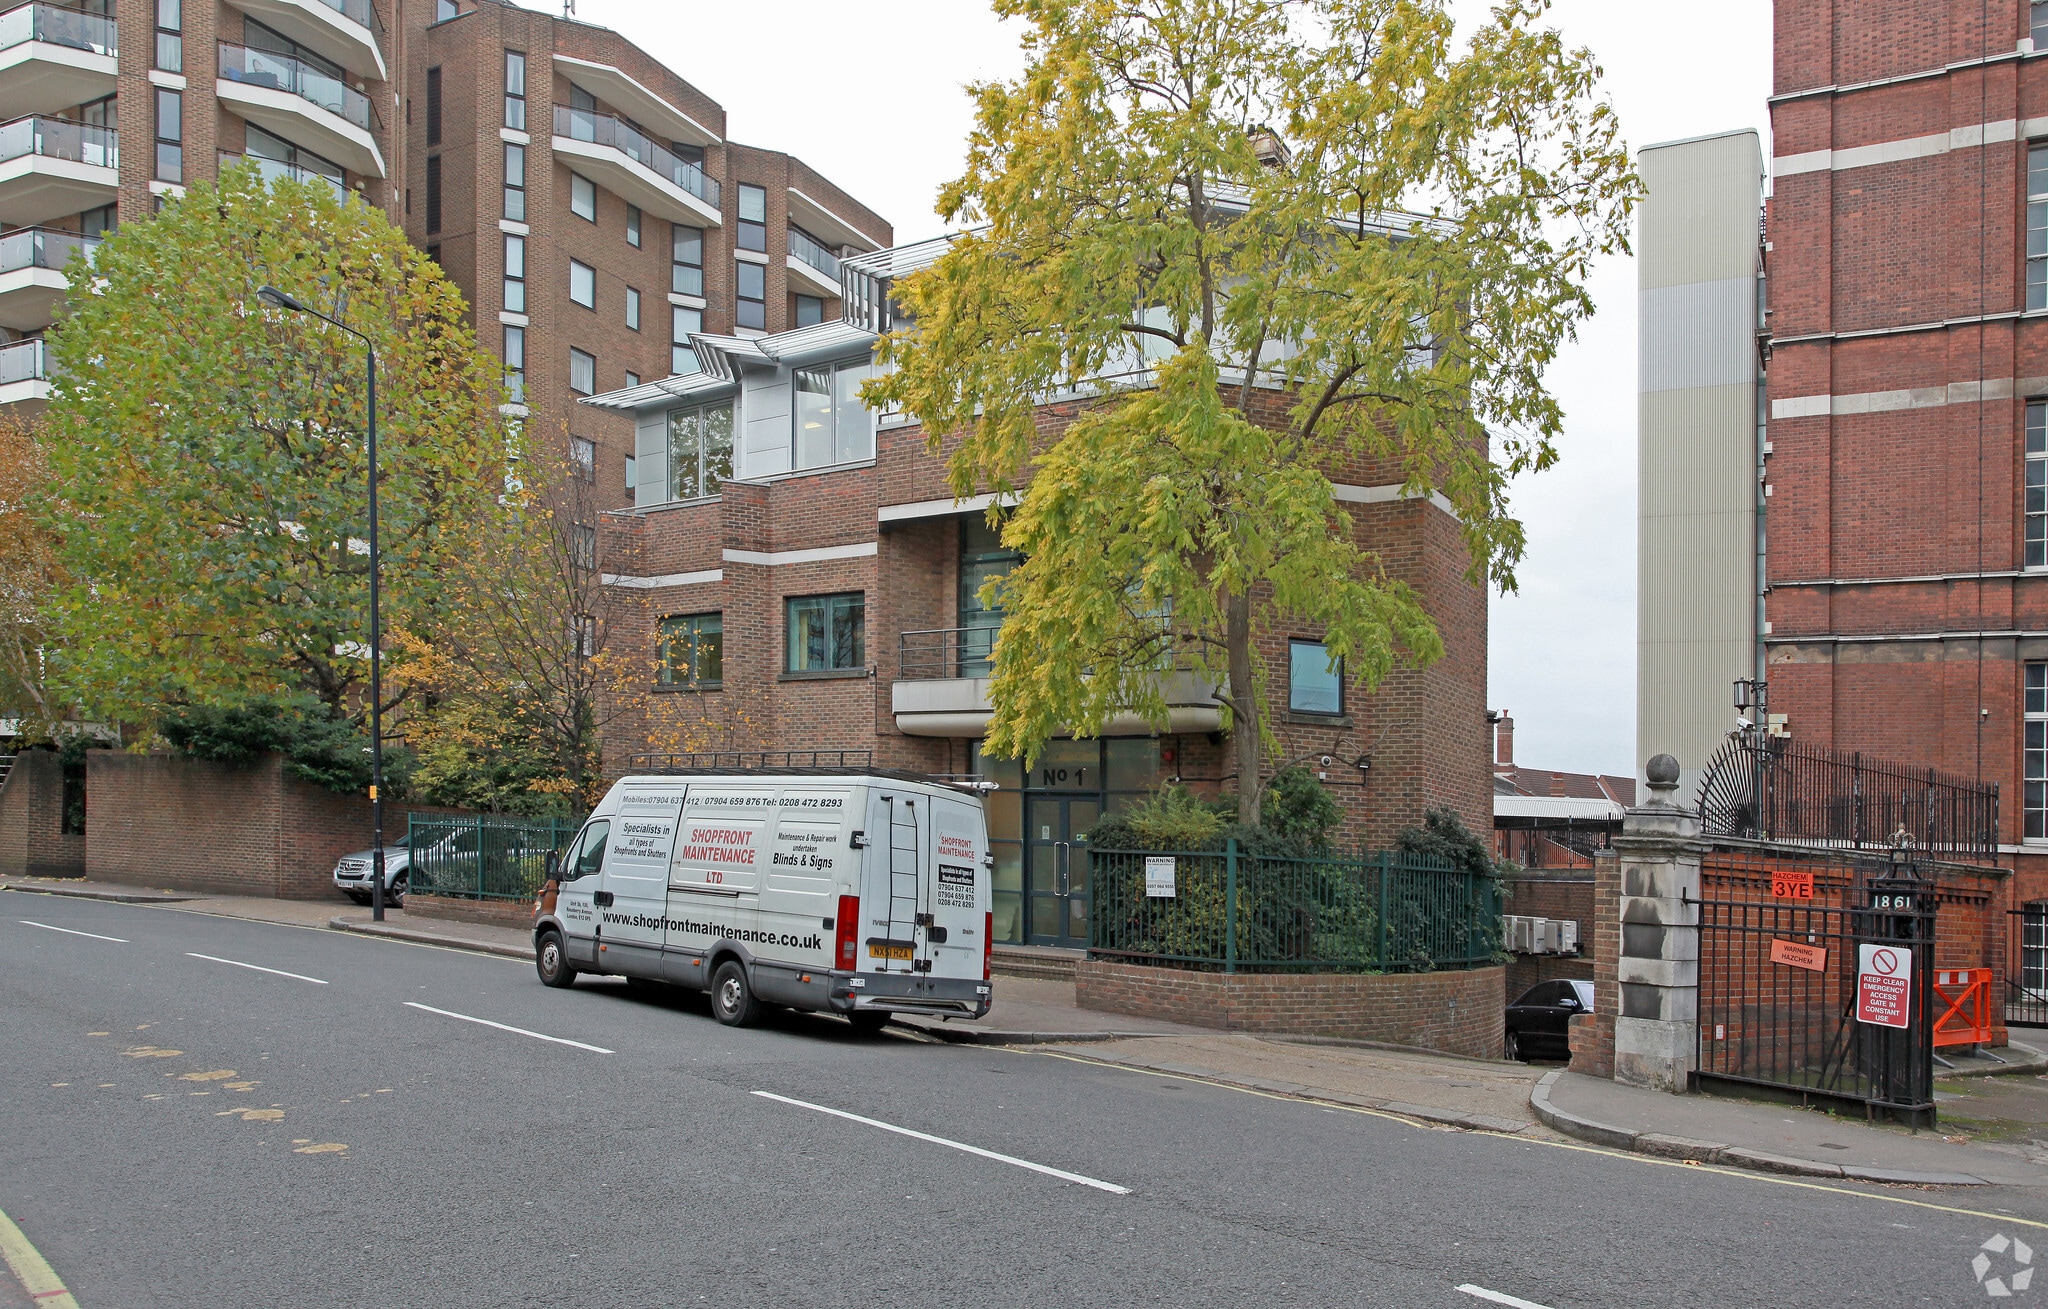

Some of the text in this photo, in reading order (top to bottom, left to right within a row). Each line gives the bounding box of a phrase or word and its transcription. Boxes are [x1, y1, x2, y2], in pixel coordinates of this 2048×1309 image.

[1044, 768, 1082, 786] No 1
[670, 796, 683, 804] 637
[686, 797, 700, 806] 412
[730, 798, 744, 806] 659
[746, 798, 760, 806] 876
[762, 798, 776, 806] Tel:
[778, 798, 800, 806] 0208
[802, 798, 818, 808] 472
[820, 799, 842, 808] 8293
[623, 822, 670, 835] Specialists in
[692, 828, 752, 845] SHOPFRONT
[778, 832, 805, 842] Maintenance
[810, 834, 824, 844] Repair
[941, 836, 972, 848] SHOPFRONT
[636, 839, 648, 848] types
[649, 840, 654, 848] of
[792, 844, 818, 852] undertaken
[614, 846, 637, 856] Shopfronts
[646, 849, 667, 858] Shutters
[682, 846, 756, 864] MAINTENANCE
[938, 846, 974, 859] MAINTENANCE
[773, 853, 832, 870] Blinds & Signs
[706, 872, 722, 884] LTD
[1772, 873, 1807, 881] HAZCHEM
[1776, 882, 1809, 898] 3YE
[938, 898, 950, 906] 0208
[1874, 896, 1910, 908] 1861
[602, 912, 822, 949] www.shopfrontmaintenance.co.uk
[894, 948, 908, 958] HZA
[1784, 946, 1813, 956] WARNING
[1782, 953, 1812, 965] HAZCHEM
[1864, 984, 1904, 994] EMERGENCY
[1870, 992, 1896, 1000] ACCESS
[1866, 1006, 1900, 1016] CONSTANT
